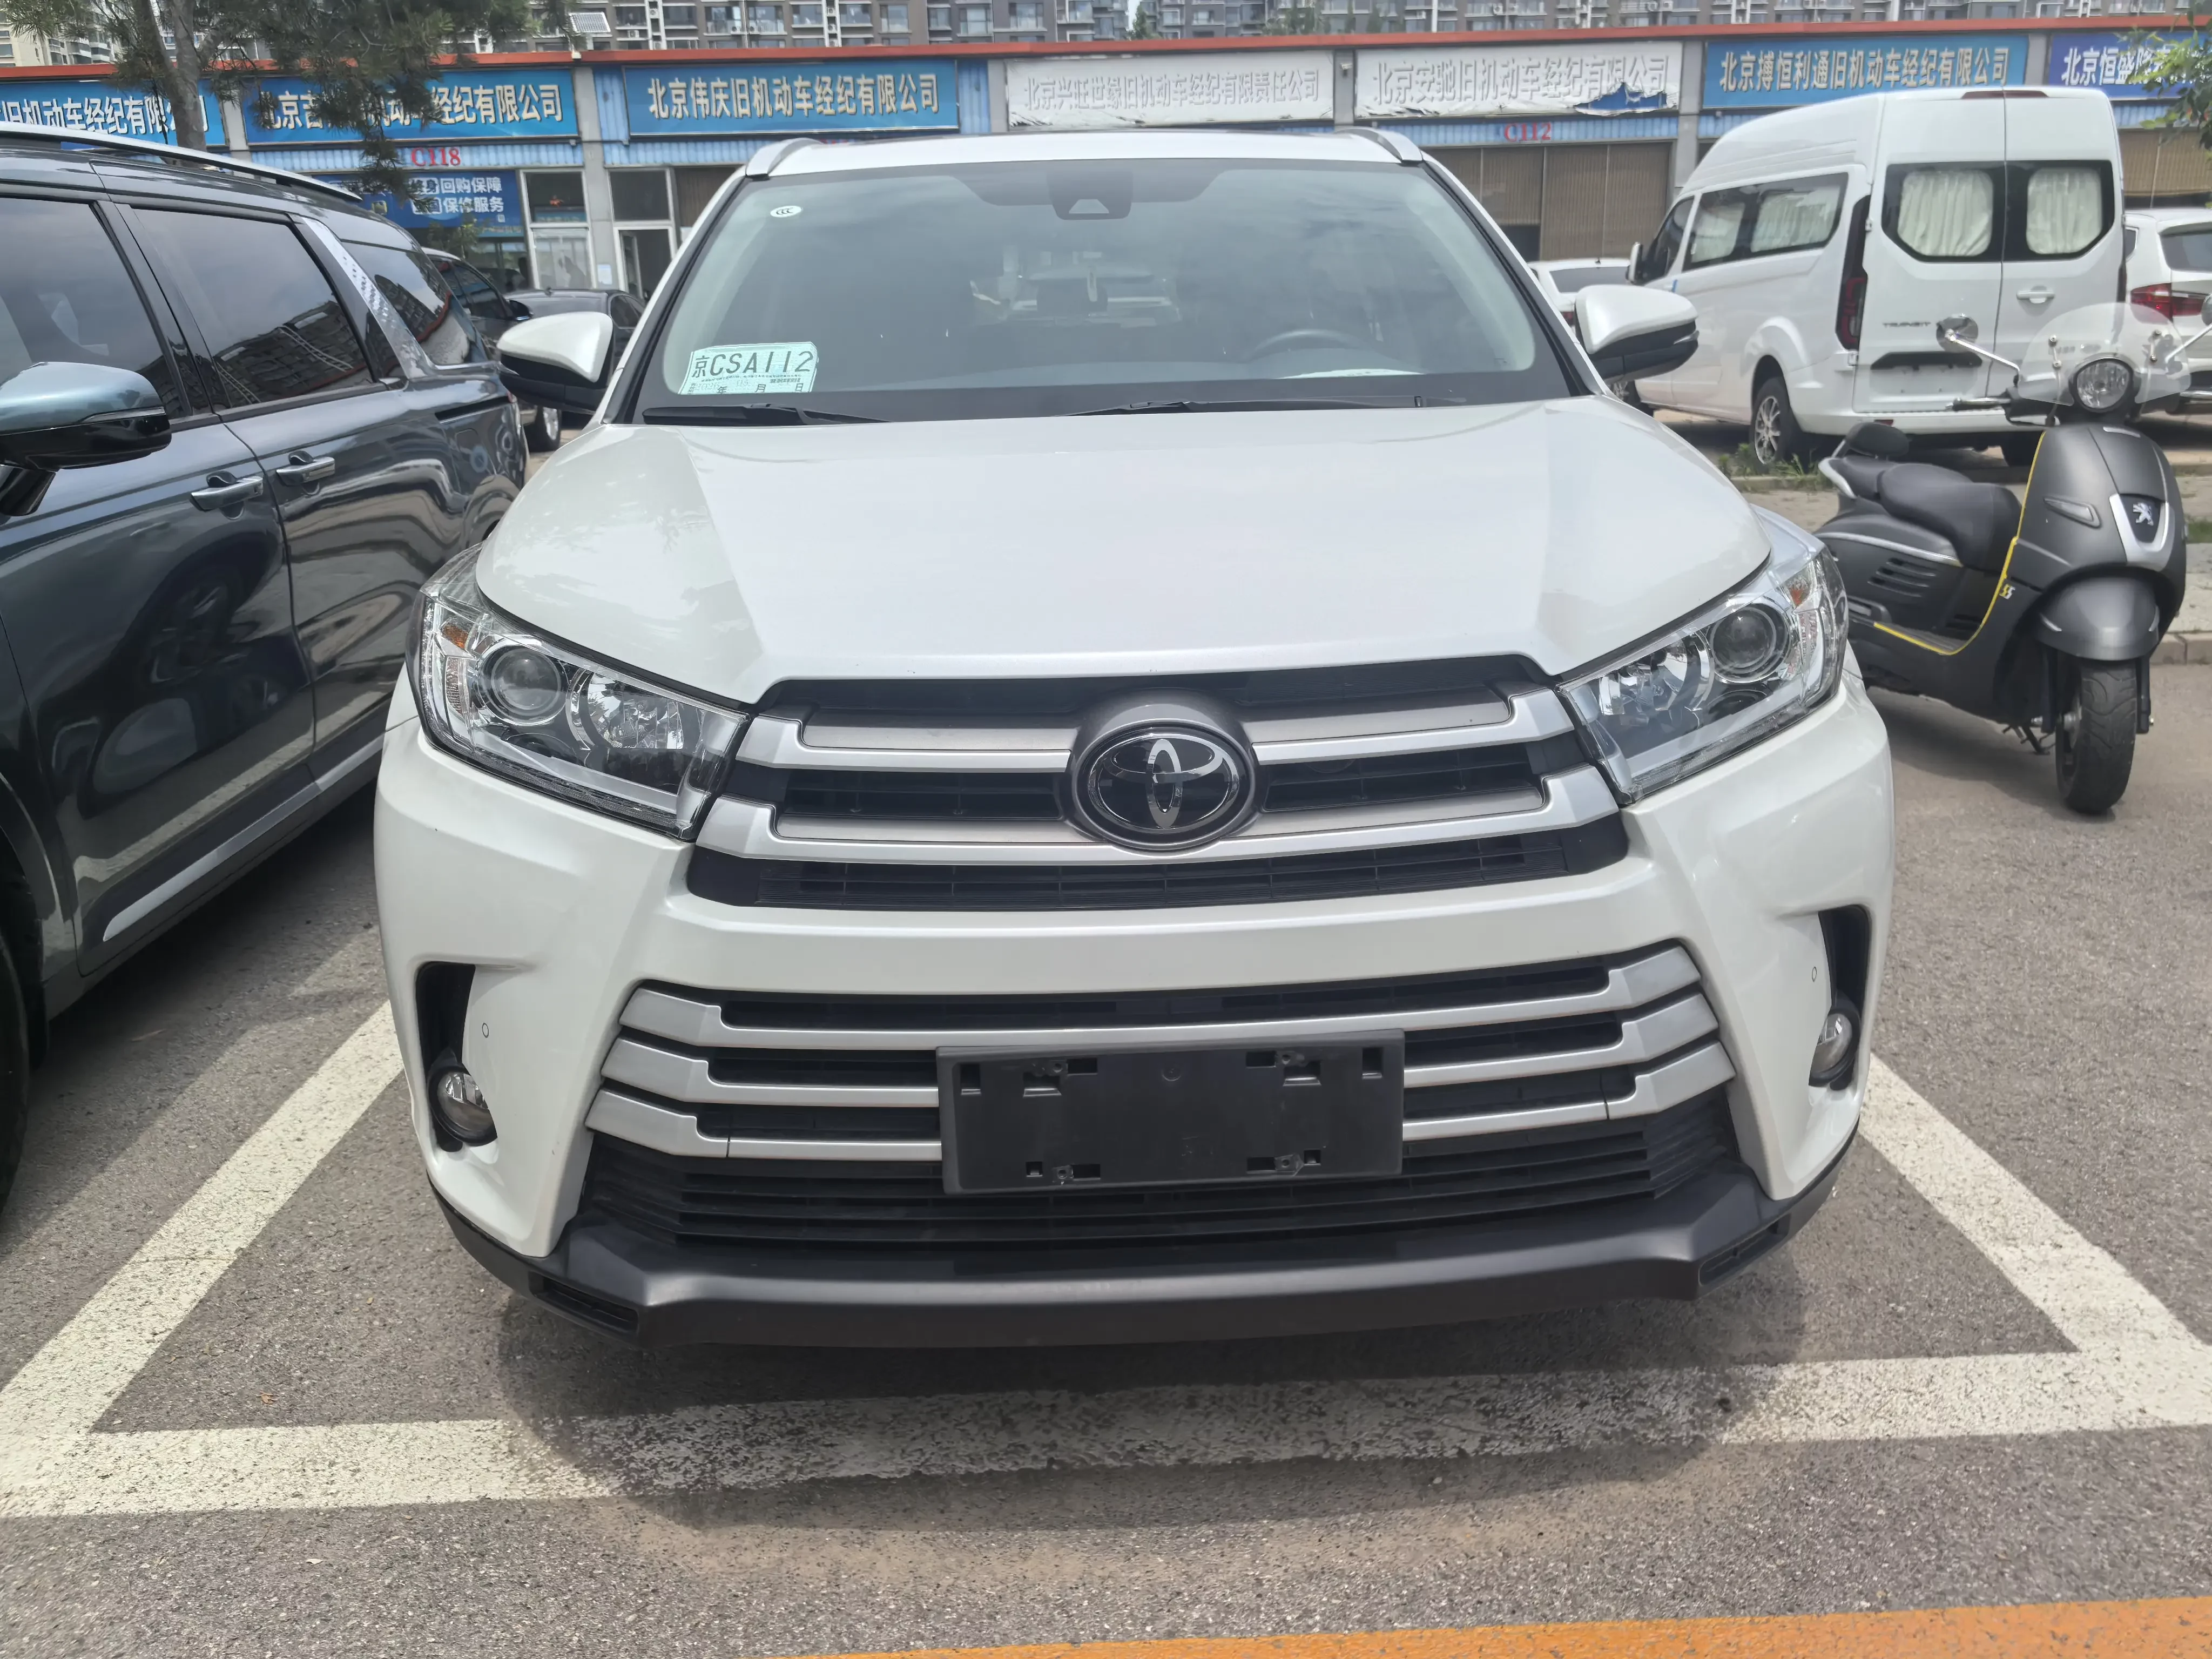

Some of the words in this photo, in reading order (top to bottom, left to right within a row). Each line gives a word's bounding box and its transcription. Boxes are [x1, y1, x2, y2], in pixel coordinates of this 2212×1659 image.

[648, 73, 939, 119] 北京伟庆旧机动车经纪有限公司
[1503, 122, 1553, 143] C112
[411, 147, 461, 166] C118
[692, 350, 814, 378] 京CSA112
[754, 384, 767, 393] 月
[794, 383, 804, 393] 日
